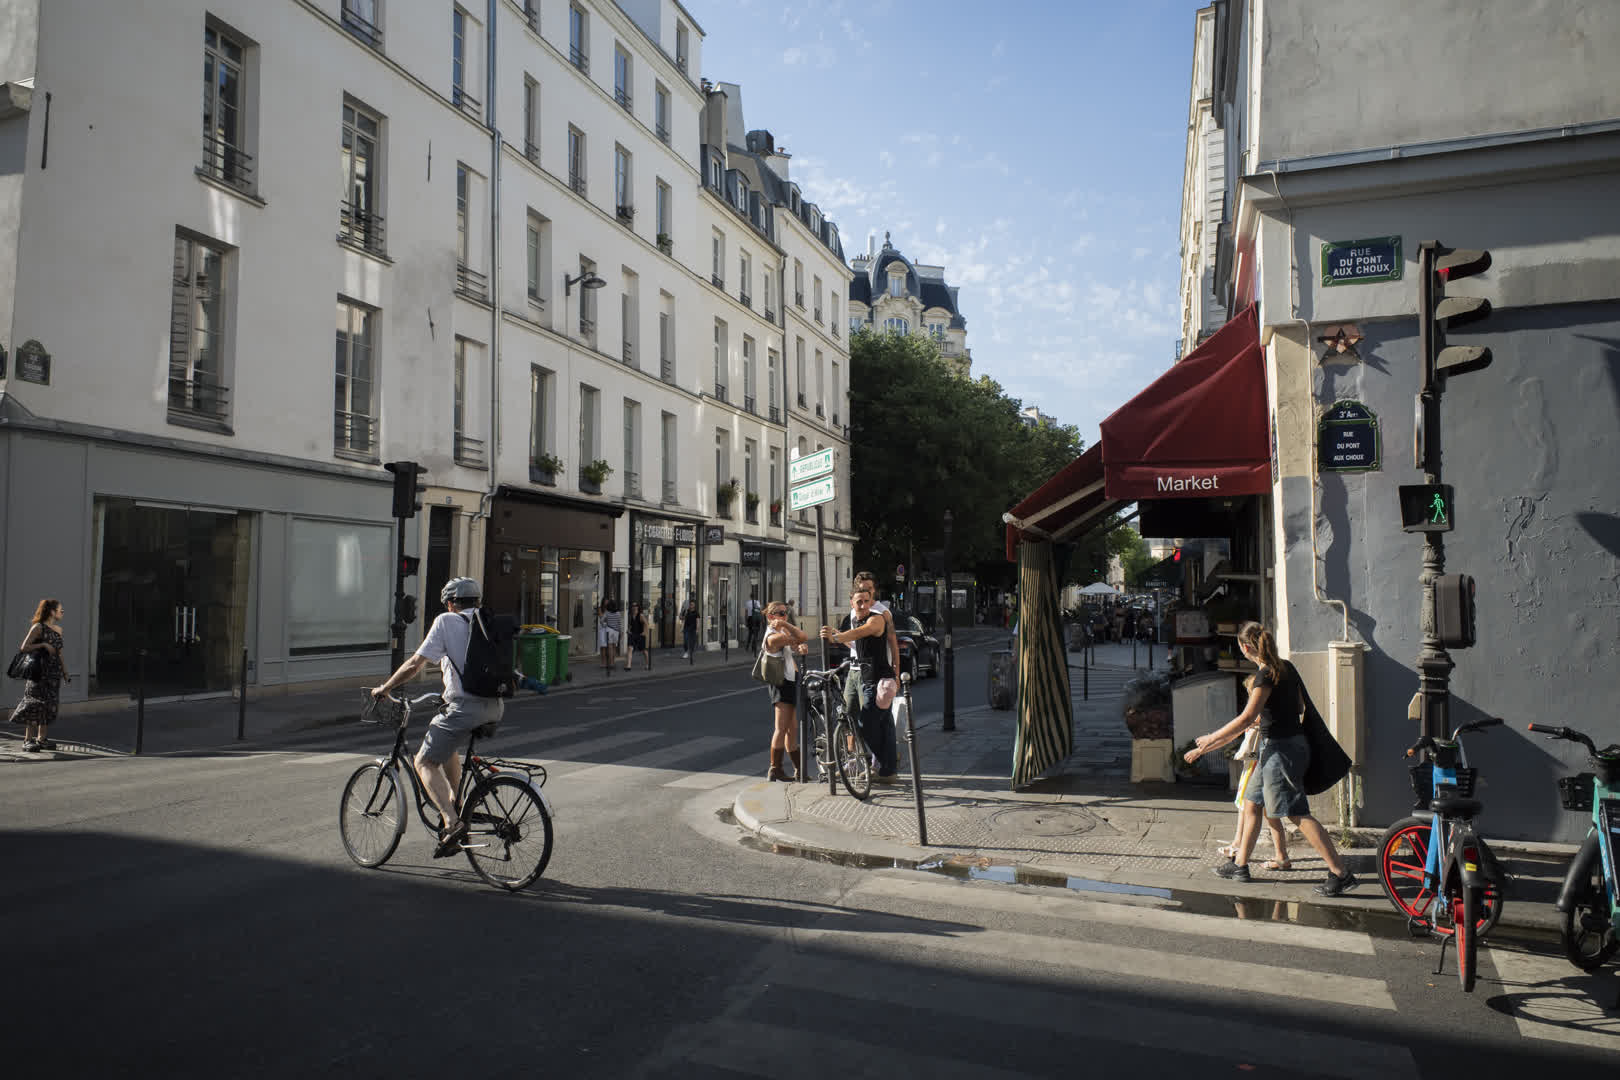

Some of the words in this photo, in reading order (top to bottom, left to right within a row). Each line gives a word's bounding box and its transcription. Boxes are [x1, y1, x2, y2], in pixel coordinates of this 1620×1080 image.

[1350, 248, 1371, 257] RUE
[1340, 259, 1353, 267] DU
[1356, 256, 1382, 265] PONT
[1333, 267, 1353, 276] AUX
[1356, 263, 1390, 274] CHOUX
[1157, 475, 1219, 491] Market
